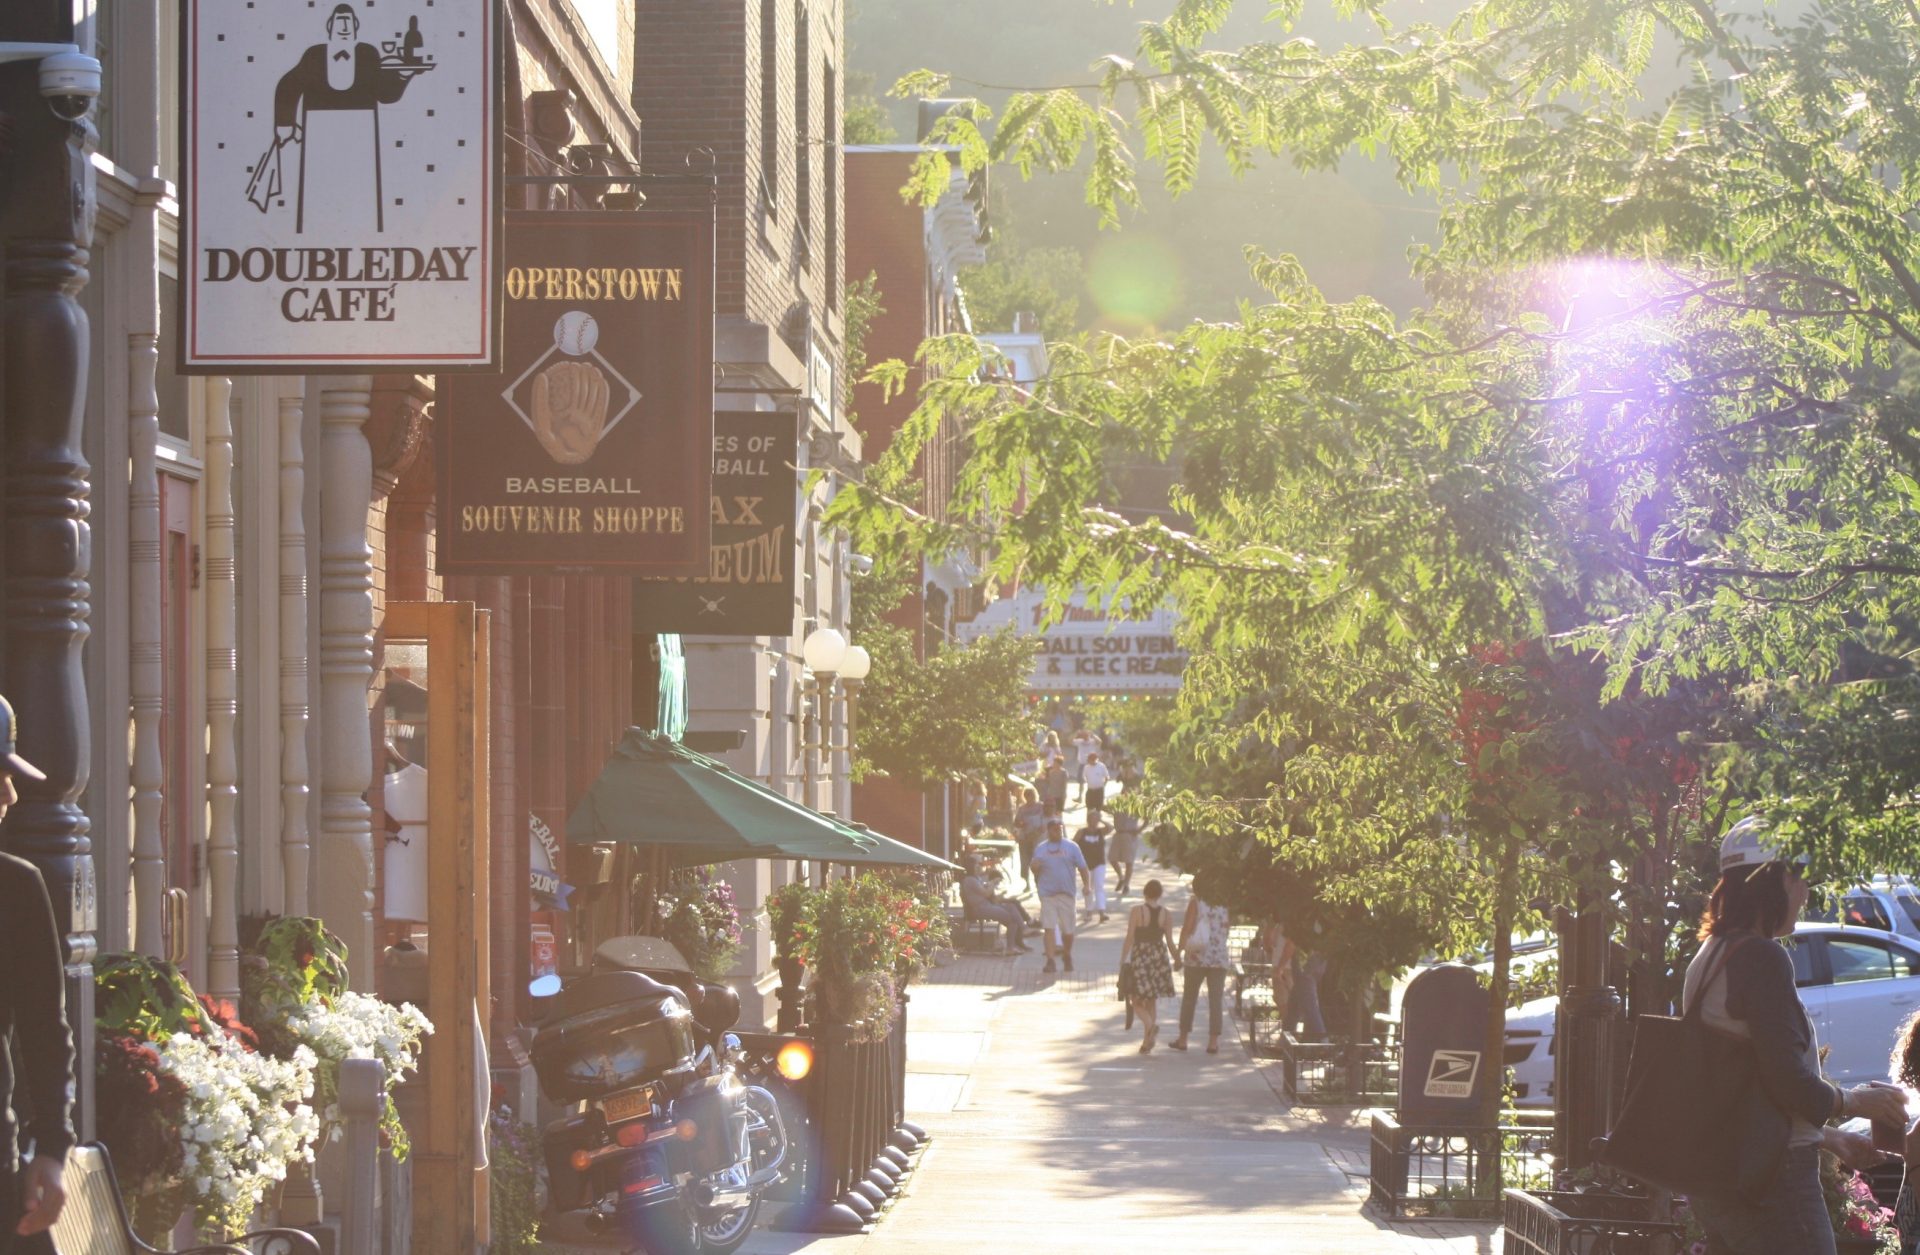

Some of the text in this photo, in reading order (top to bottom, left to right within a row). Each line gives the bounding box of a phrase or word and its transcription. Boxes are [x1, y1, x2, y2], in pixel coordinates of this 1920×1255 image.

[203, 246, 477, 282] DOUBLEDAY
[505, 267, 683, 300] OPERSTOWN
[714, 436, 776, 453] ES OF
[715, 458, 770, 476] BALL
[505, 477, 641, 494] BASEBALL
[462, 504, 685, 534] SOUVENIR SHOPPE
[711, 495, 764, 525] AX
[1035, 635, 1088, 655] BALL
